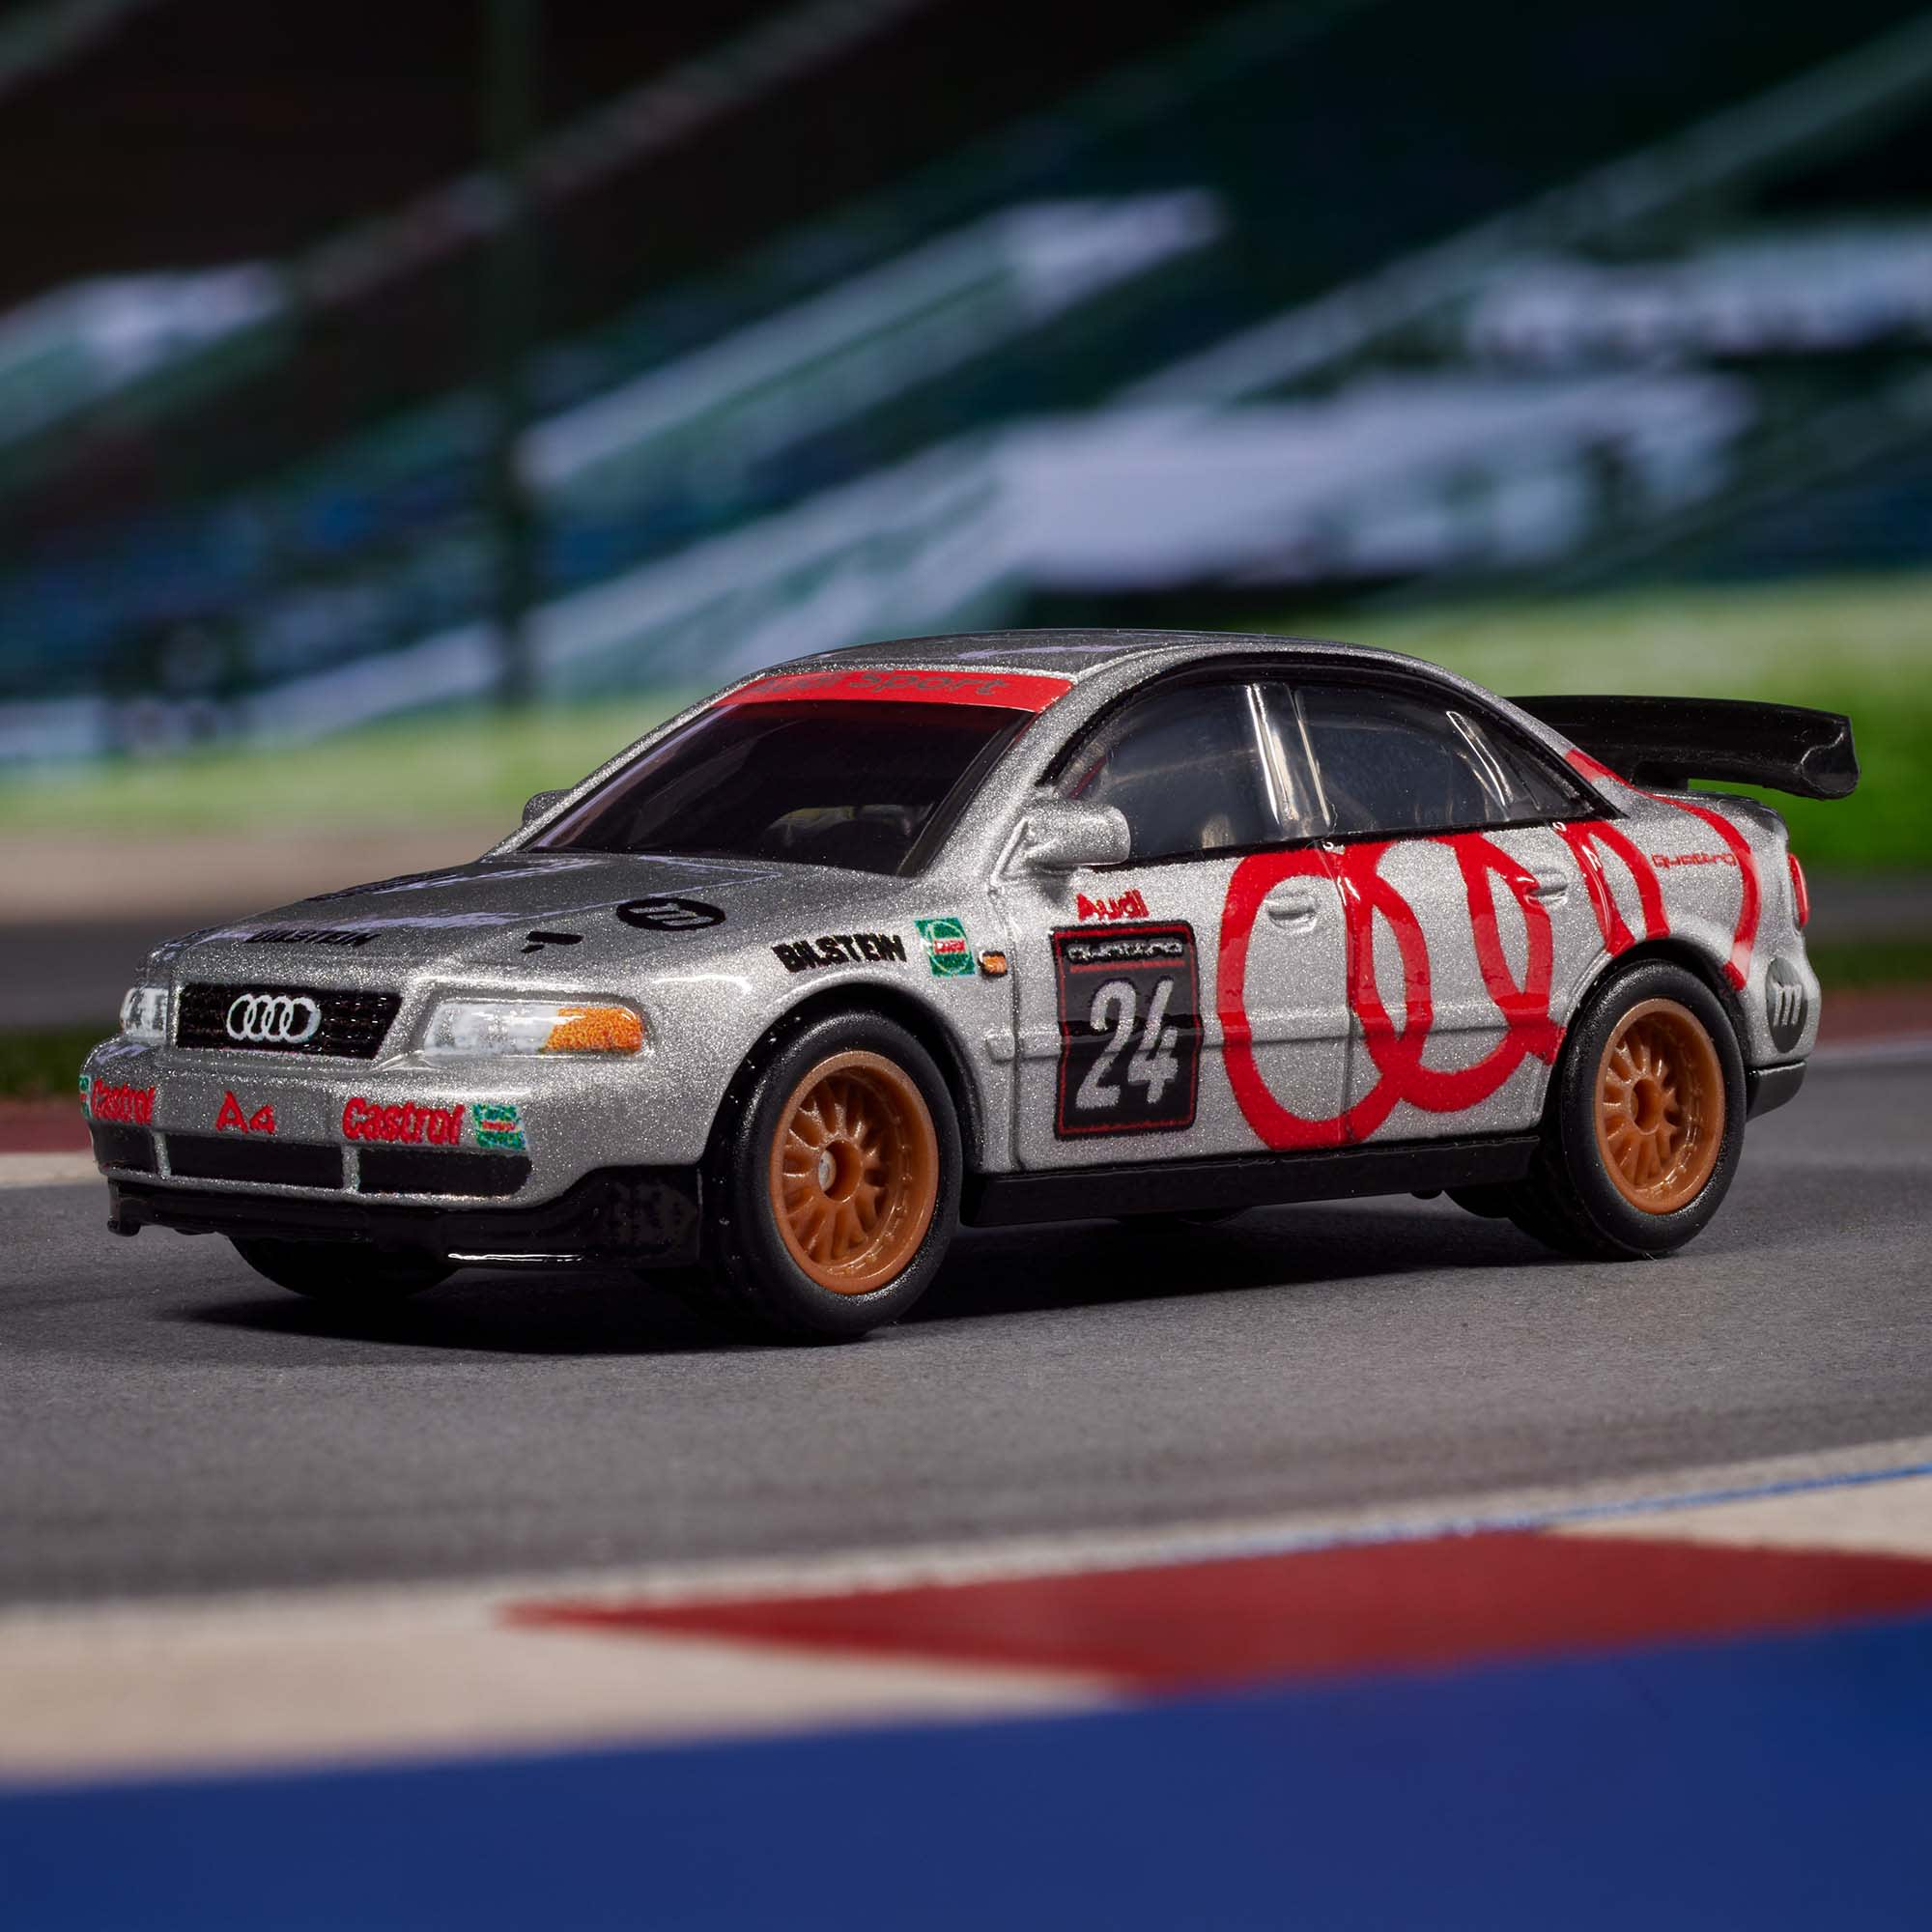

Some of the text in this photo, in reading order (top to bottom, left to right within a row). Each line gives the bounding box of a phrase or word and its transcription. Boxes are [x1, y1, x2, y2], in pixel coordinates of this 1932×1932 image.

[1076, 890, 1150, 923] Audi
[771, 932, 908, 974] BILSTEIN
[1075, 978, 1179, 1109] 24
[215, 1091, 275, 1134] A4
[341, 1096, 466, 1147] Castrol
